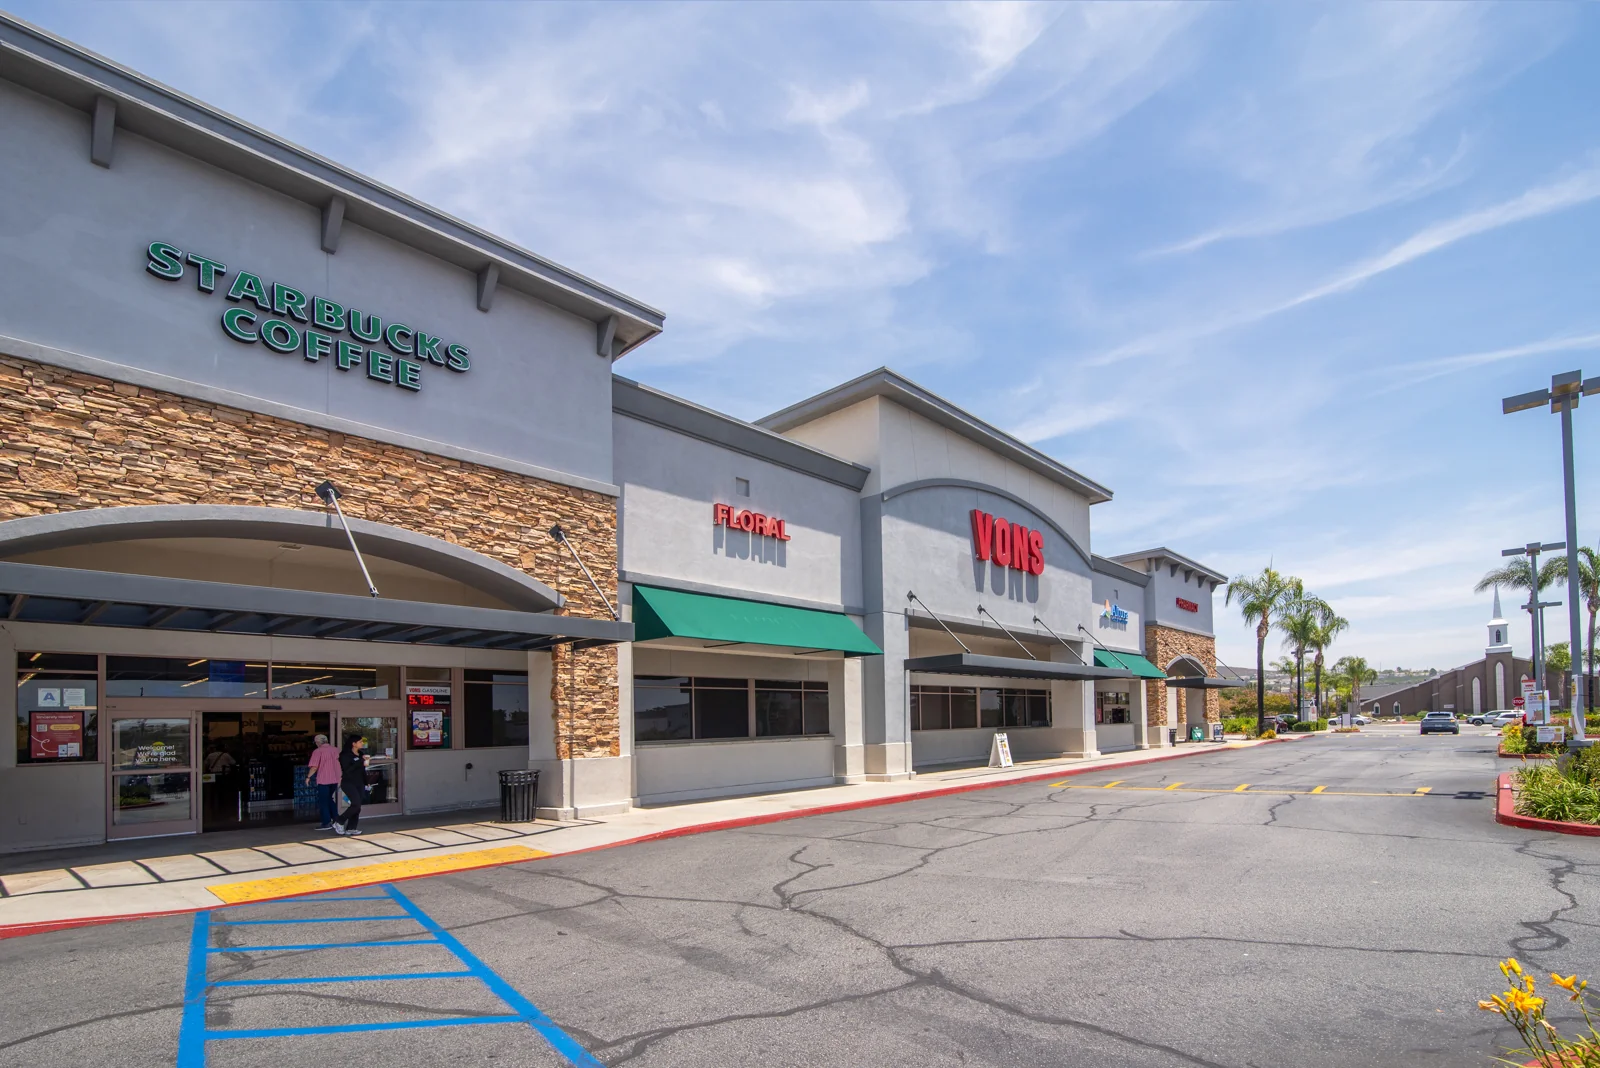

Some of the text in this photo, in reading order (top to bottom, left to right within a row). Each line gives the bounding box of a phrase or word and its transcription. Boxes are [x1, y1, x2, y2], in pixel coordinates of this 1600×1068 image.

[146, 241, 471, 373] STARBUCKS
[221, 307, 422, 392] COFFEE
[713, 503, 791, 541] FLORAL
[970, 508, 1045, 576] VONS
